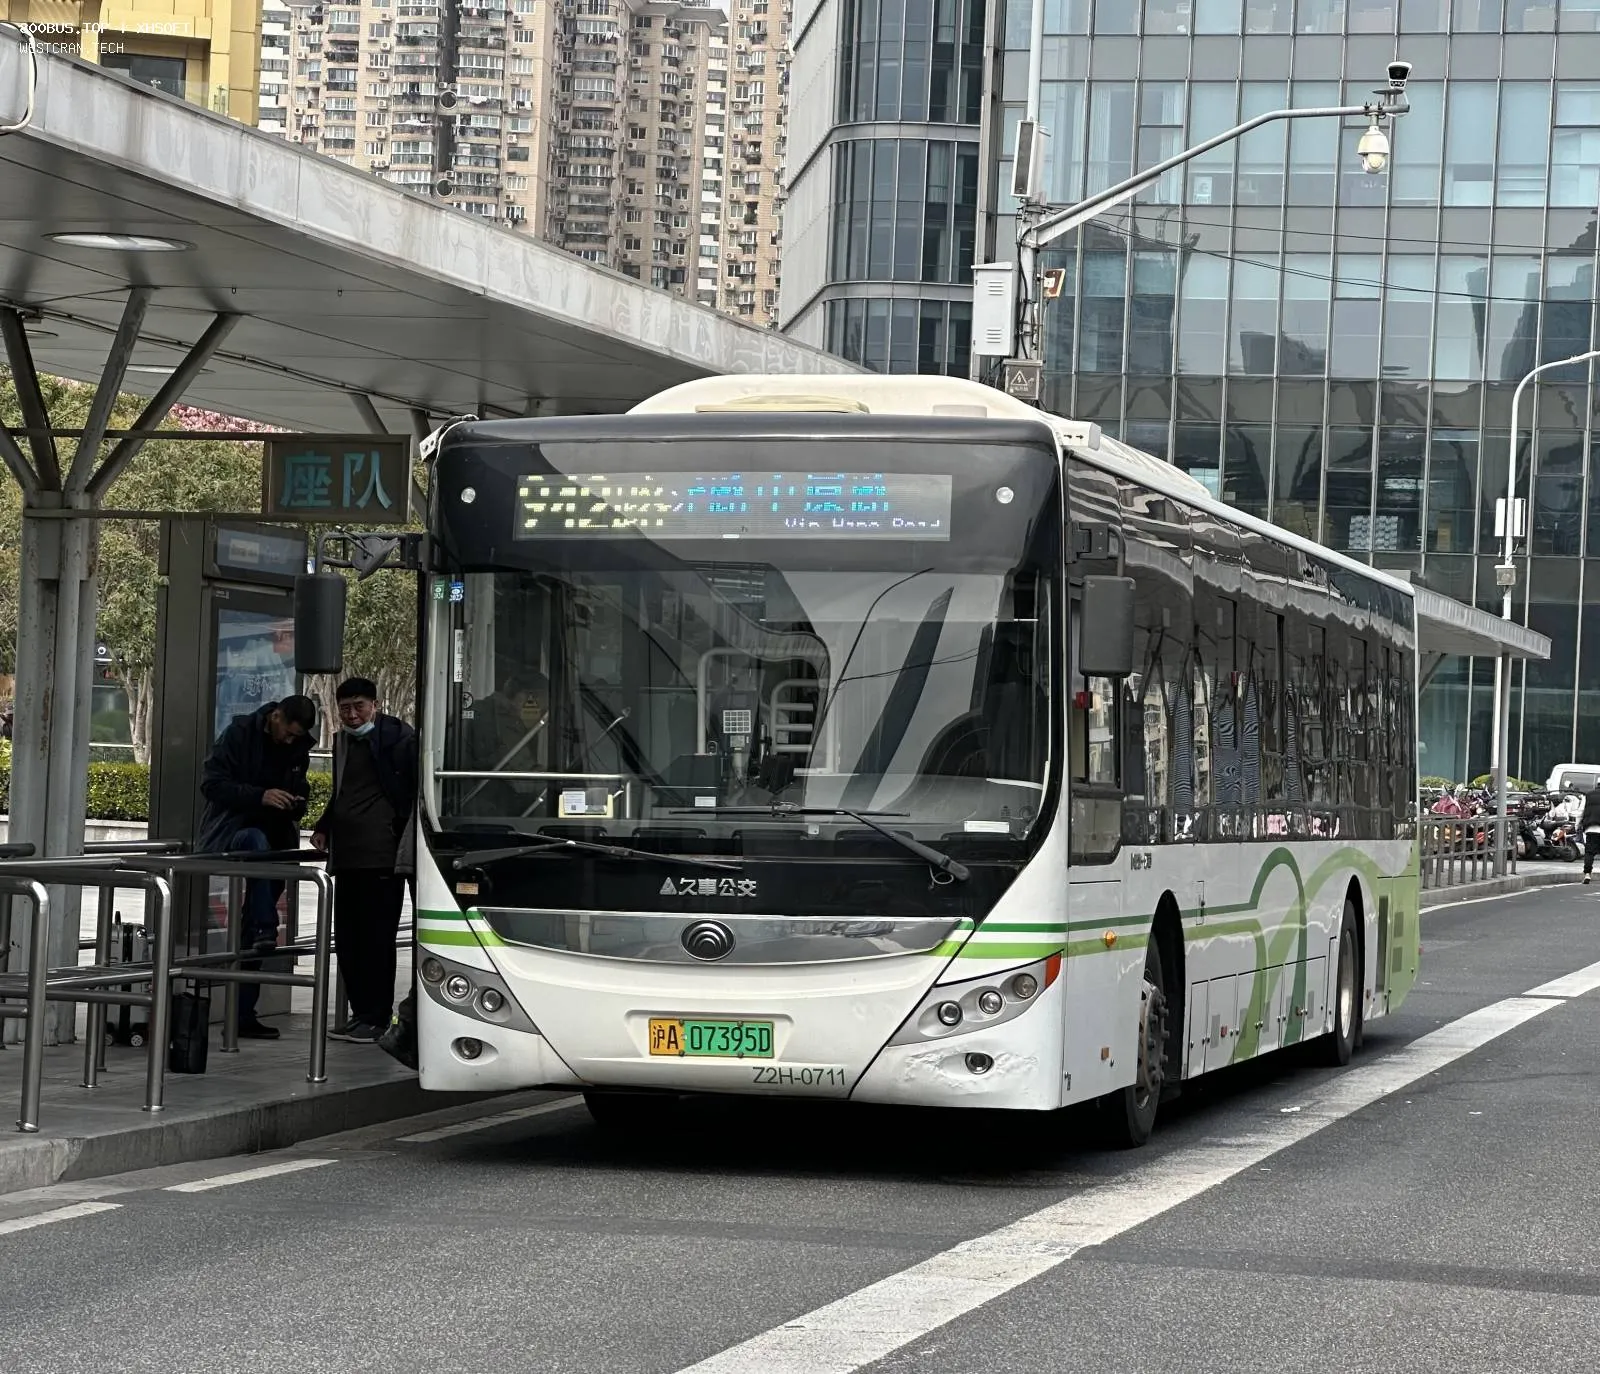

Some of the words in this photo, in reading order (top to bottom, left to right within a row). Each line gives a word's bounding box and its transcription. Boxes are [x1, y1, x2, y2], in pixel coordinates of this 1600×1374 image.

[280, 450, 392, 509] 座队
[678, 877, 757, 897] 久事公交
[690, 1025, 771, 1053] 07395D
[752, 1066, 846, 1086] Z2H-0711
